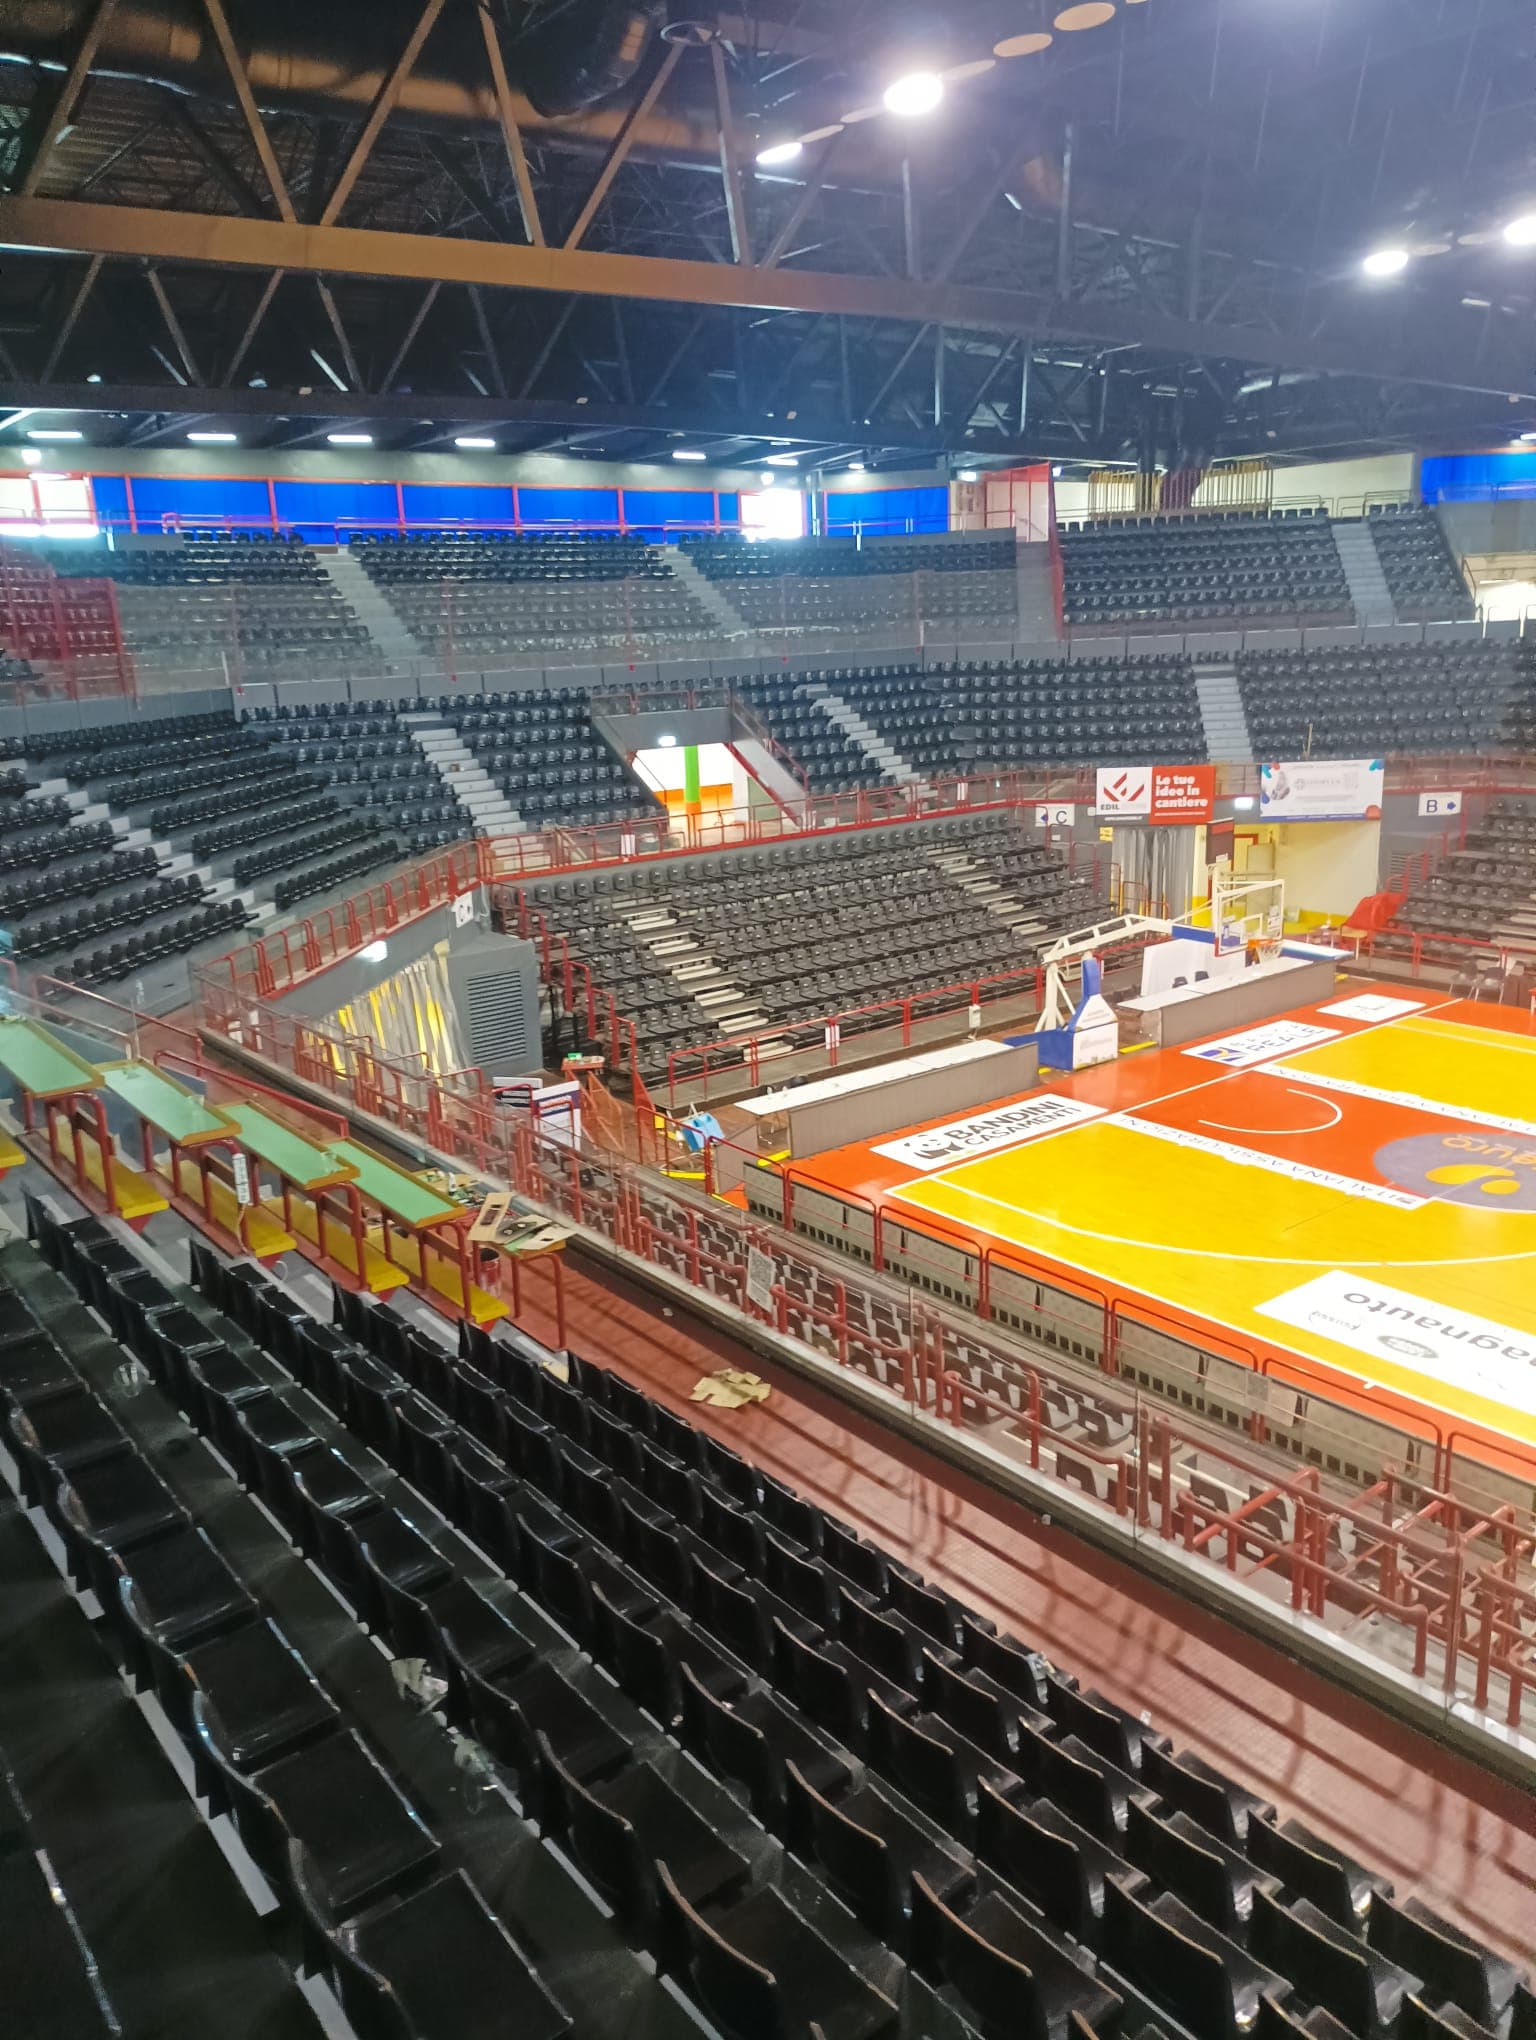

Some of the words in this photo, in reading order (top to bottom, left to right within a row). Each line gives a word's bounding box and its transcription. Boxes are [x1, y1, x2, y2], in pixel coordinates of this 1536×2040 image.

[1155, 775, 1171, 786] Le
[1172, 775, 1195, 785] tue
[1155, 785, 1185, 797] idee
[1186, 784, 1200, 796] in
[1155, 796, 1209, 809] cantiere
[1427, 799, 1438, 813] B
[1055, 810, 1067, 824] C
[943, 1100, 1065, 1140] BANDINI
[965, 1106, 1083, 1147] CASAMENTI
